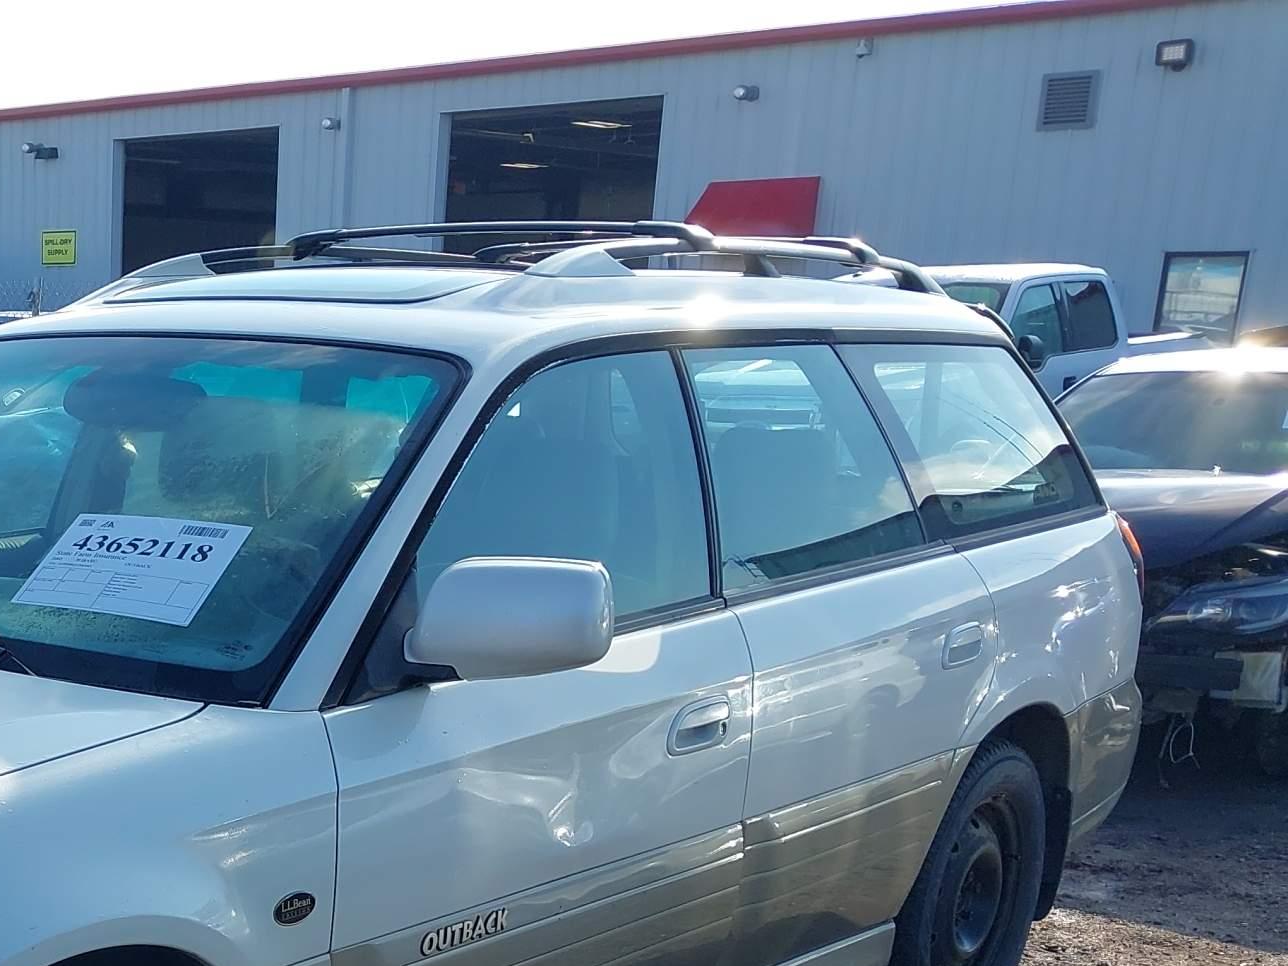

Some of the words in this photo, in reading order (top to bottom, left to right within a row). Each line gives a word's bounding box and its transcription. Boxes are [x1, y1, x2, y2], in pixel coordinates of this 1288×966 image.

[72, 534, 214, 563] 43652118
[93, 553, 128, 561] Insurance
[420, 907, 508, 956] OUTBACK
